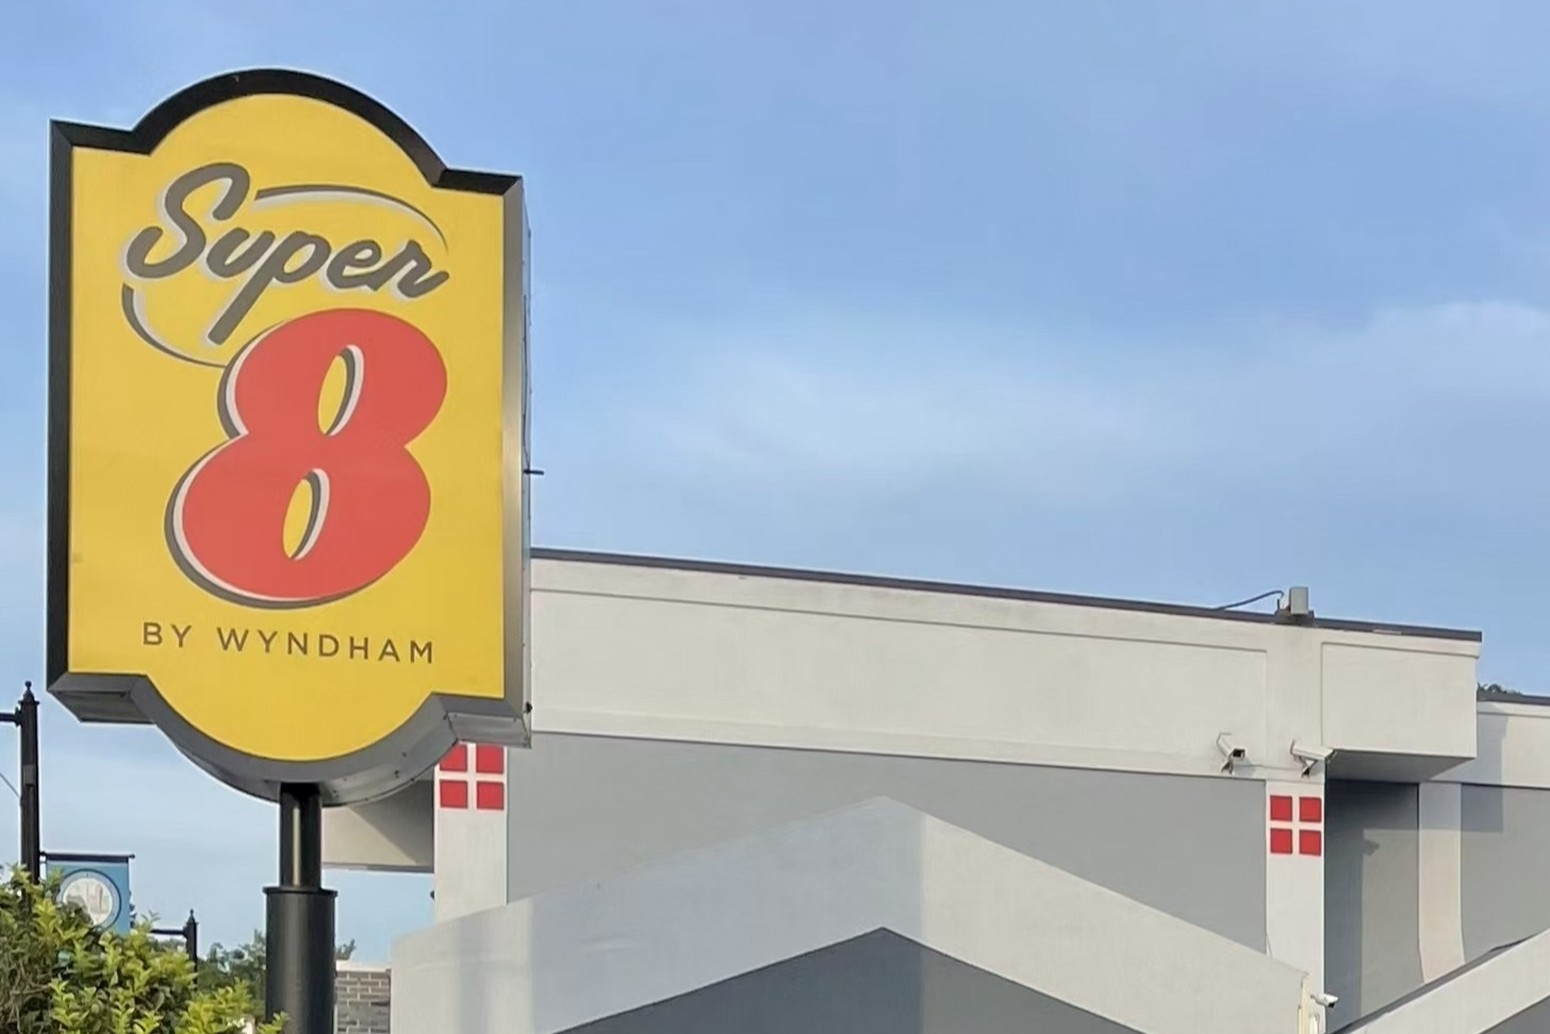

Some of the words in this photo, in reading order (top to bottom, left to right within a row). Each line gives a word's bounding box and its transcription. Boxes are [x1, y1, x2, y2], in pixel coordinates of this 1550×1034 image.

[126, 162, 450, 345] Super
[164, 308, 448, 610] 8
[143, 622, 192, 648] BY
[216, 626, 433, 664] WYNDHAM
